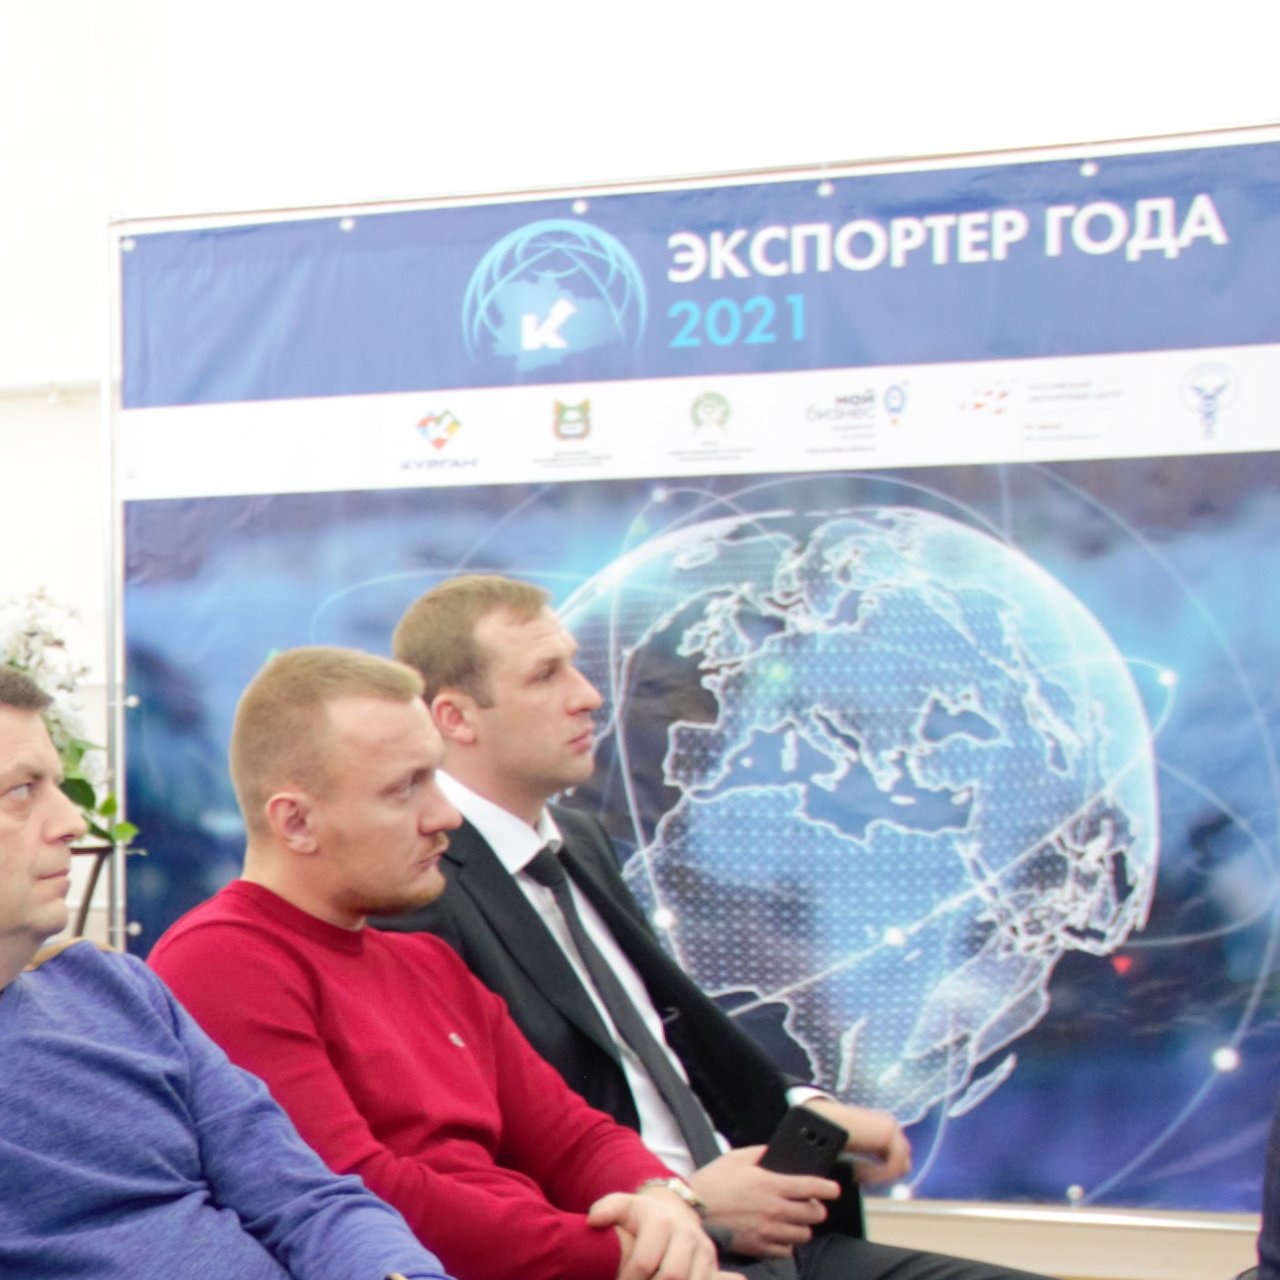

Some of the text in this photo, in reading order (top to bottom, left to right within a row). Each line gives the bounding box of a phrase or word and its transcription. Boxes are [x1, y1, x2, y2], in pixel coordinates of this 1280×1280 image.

[667, 193, 1230, 284] ЭКСПОРТЕР ГОДА
[667, 294, 806, 348] 2021
